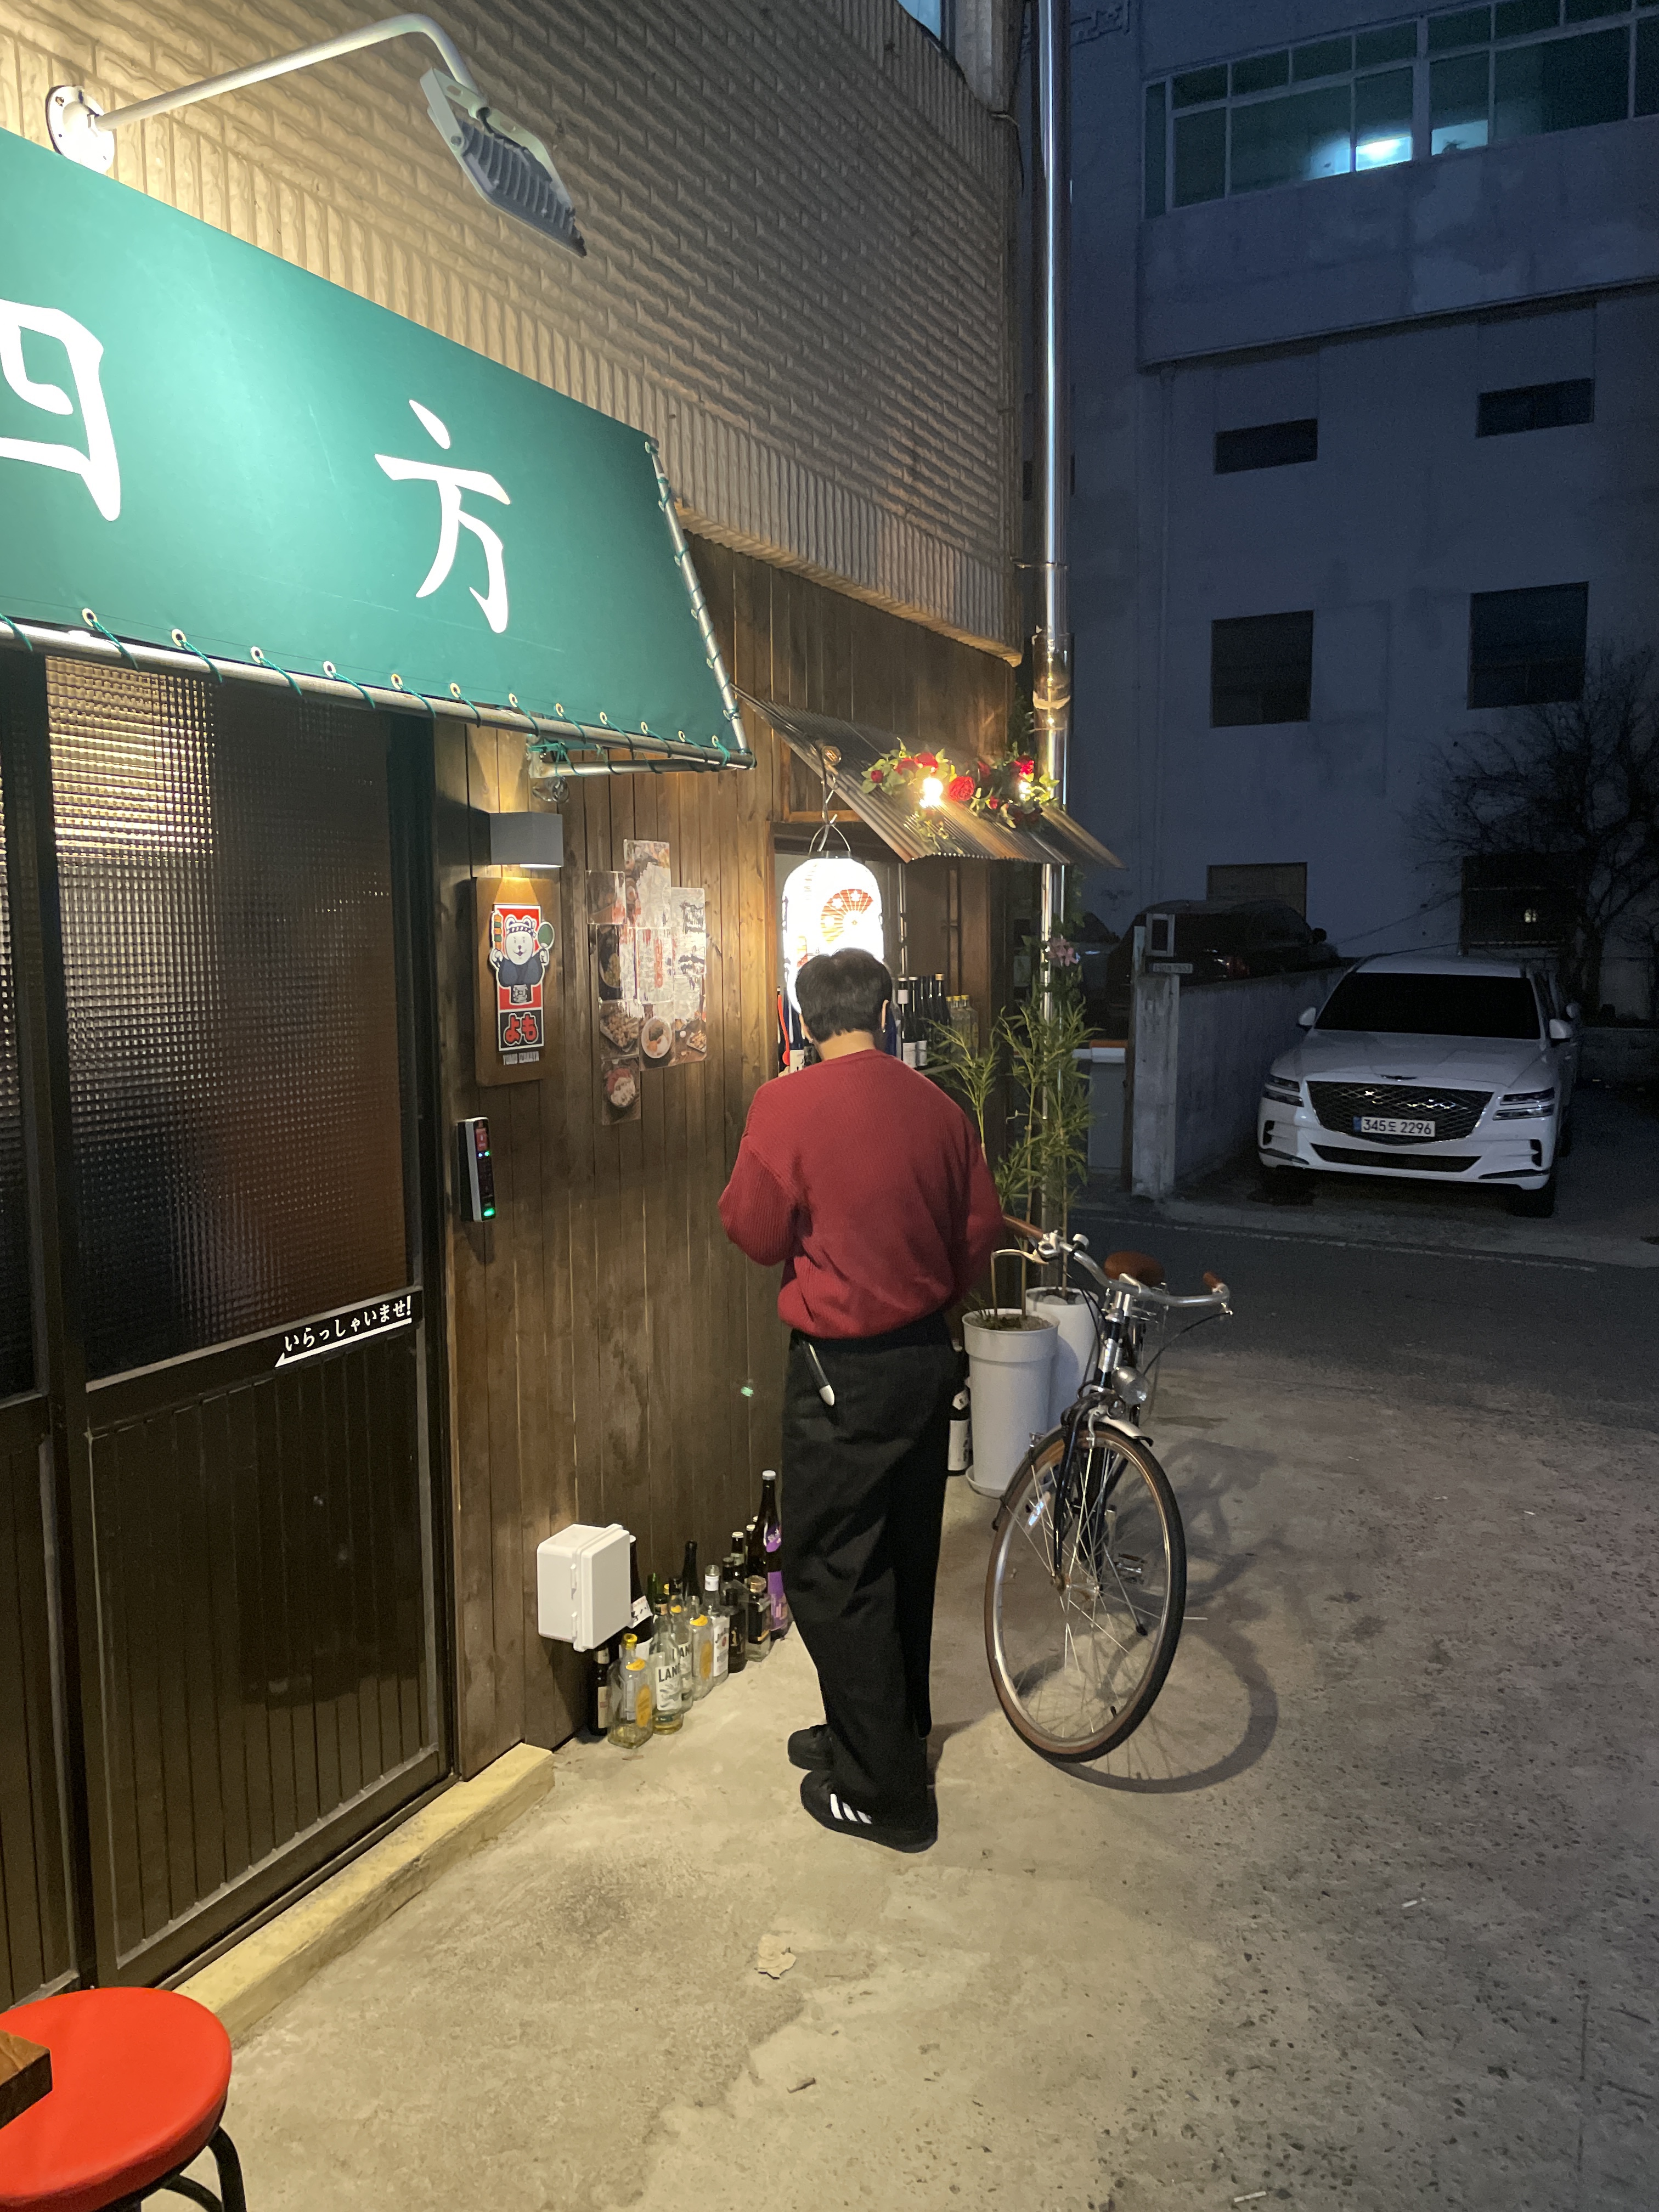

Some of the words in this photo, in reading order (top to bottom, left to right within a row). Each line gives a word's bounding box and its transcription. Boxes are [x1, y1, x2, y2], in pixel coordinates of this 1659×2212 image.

[504, 1013, 538, 1045] よも
[1363, 1119, 1397, 1132] 345도
[1400, 1121, 1432, 1135] 2296
[284, 1295, 411, 1352] いらっしゃいませ!
